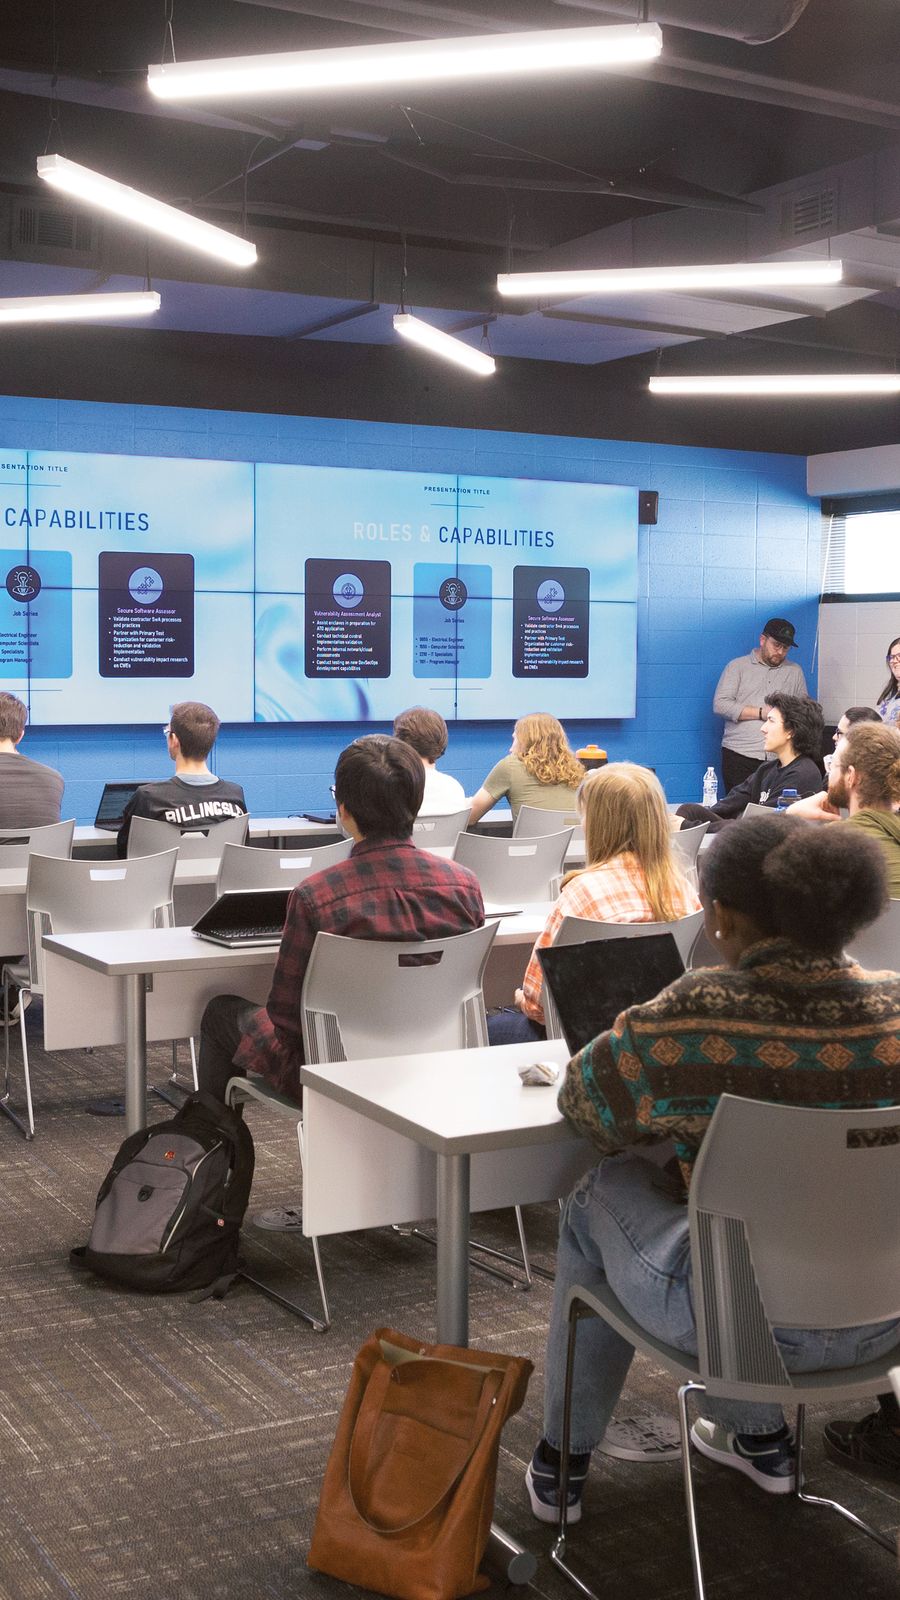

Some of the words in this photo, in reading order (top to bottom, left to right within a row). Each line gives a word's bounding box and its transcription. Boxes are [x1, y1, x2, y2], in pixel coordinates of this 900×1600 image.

[424, 486, 471, 494] PRESENTATION
[5, 508, 150, 532] CAPABILITIES
[354, 522, 412, 542] ROLES
[419, 525, 430, 542] &
[439, 526, 554, 548] CAPABILITIES
